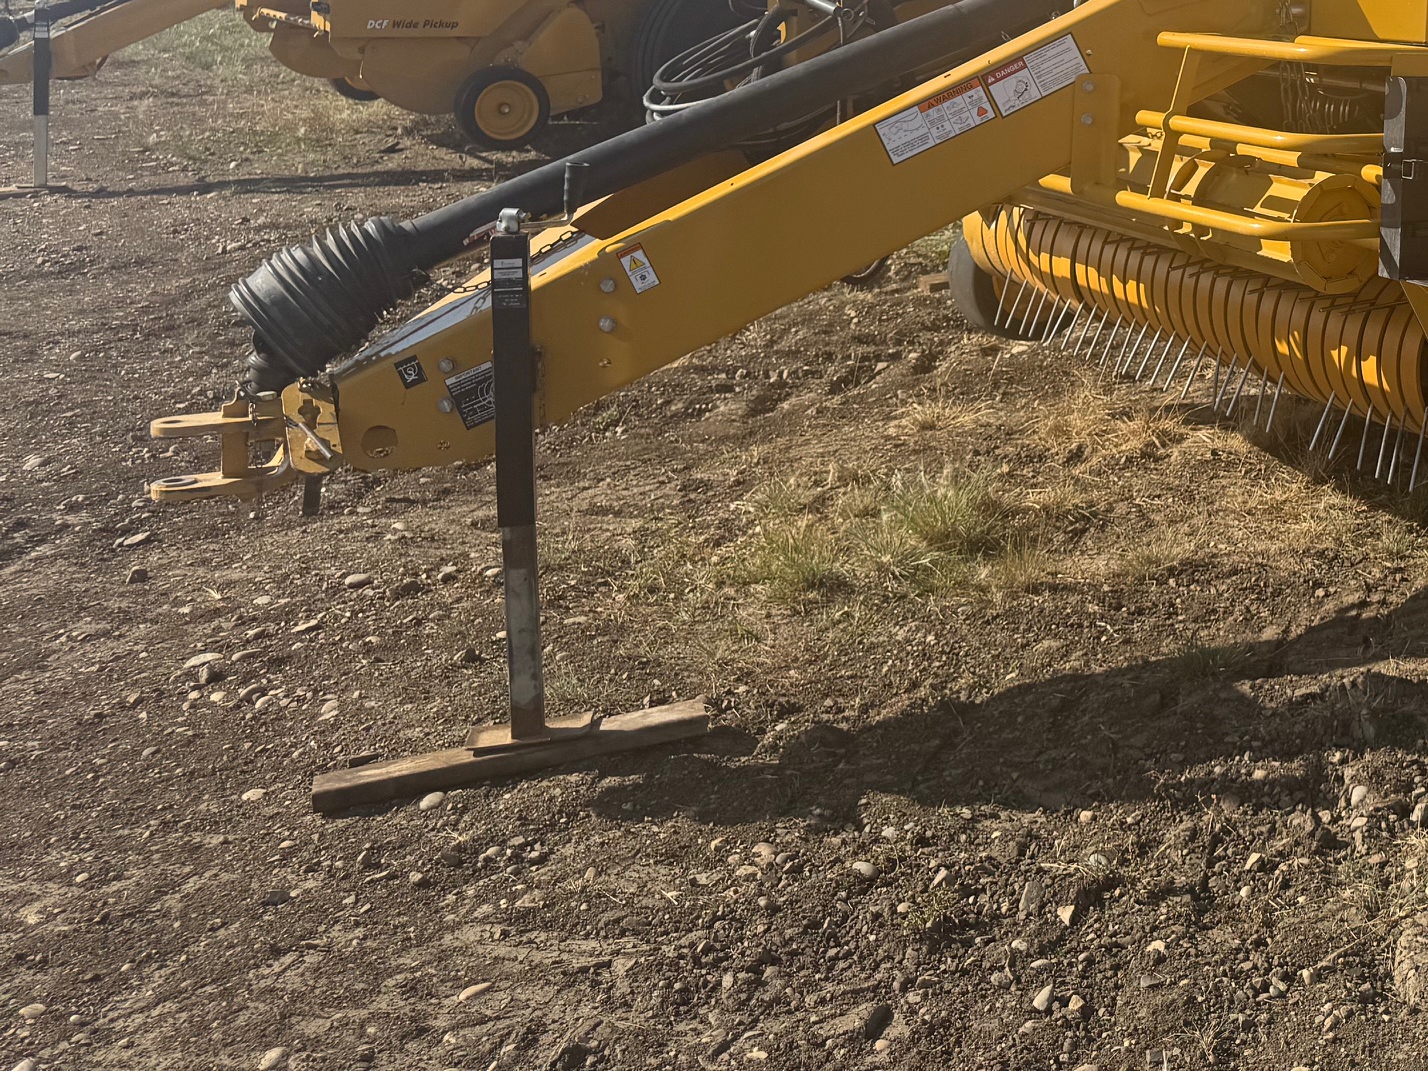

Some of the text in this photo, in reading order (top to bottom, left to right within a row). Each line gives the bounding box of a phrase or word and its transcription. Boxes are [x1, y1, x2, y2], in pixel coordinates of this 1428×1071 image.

[367, 19, 459, 30] DCF Wide Pickup
[996, 61, 1024, 79] DANGER
[933, 82, 974, 105] WARNING
